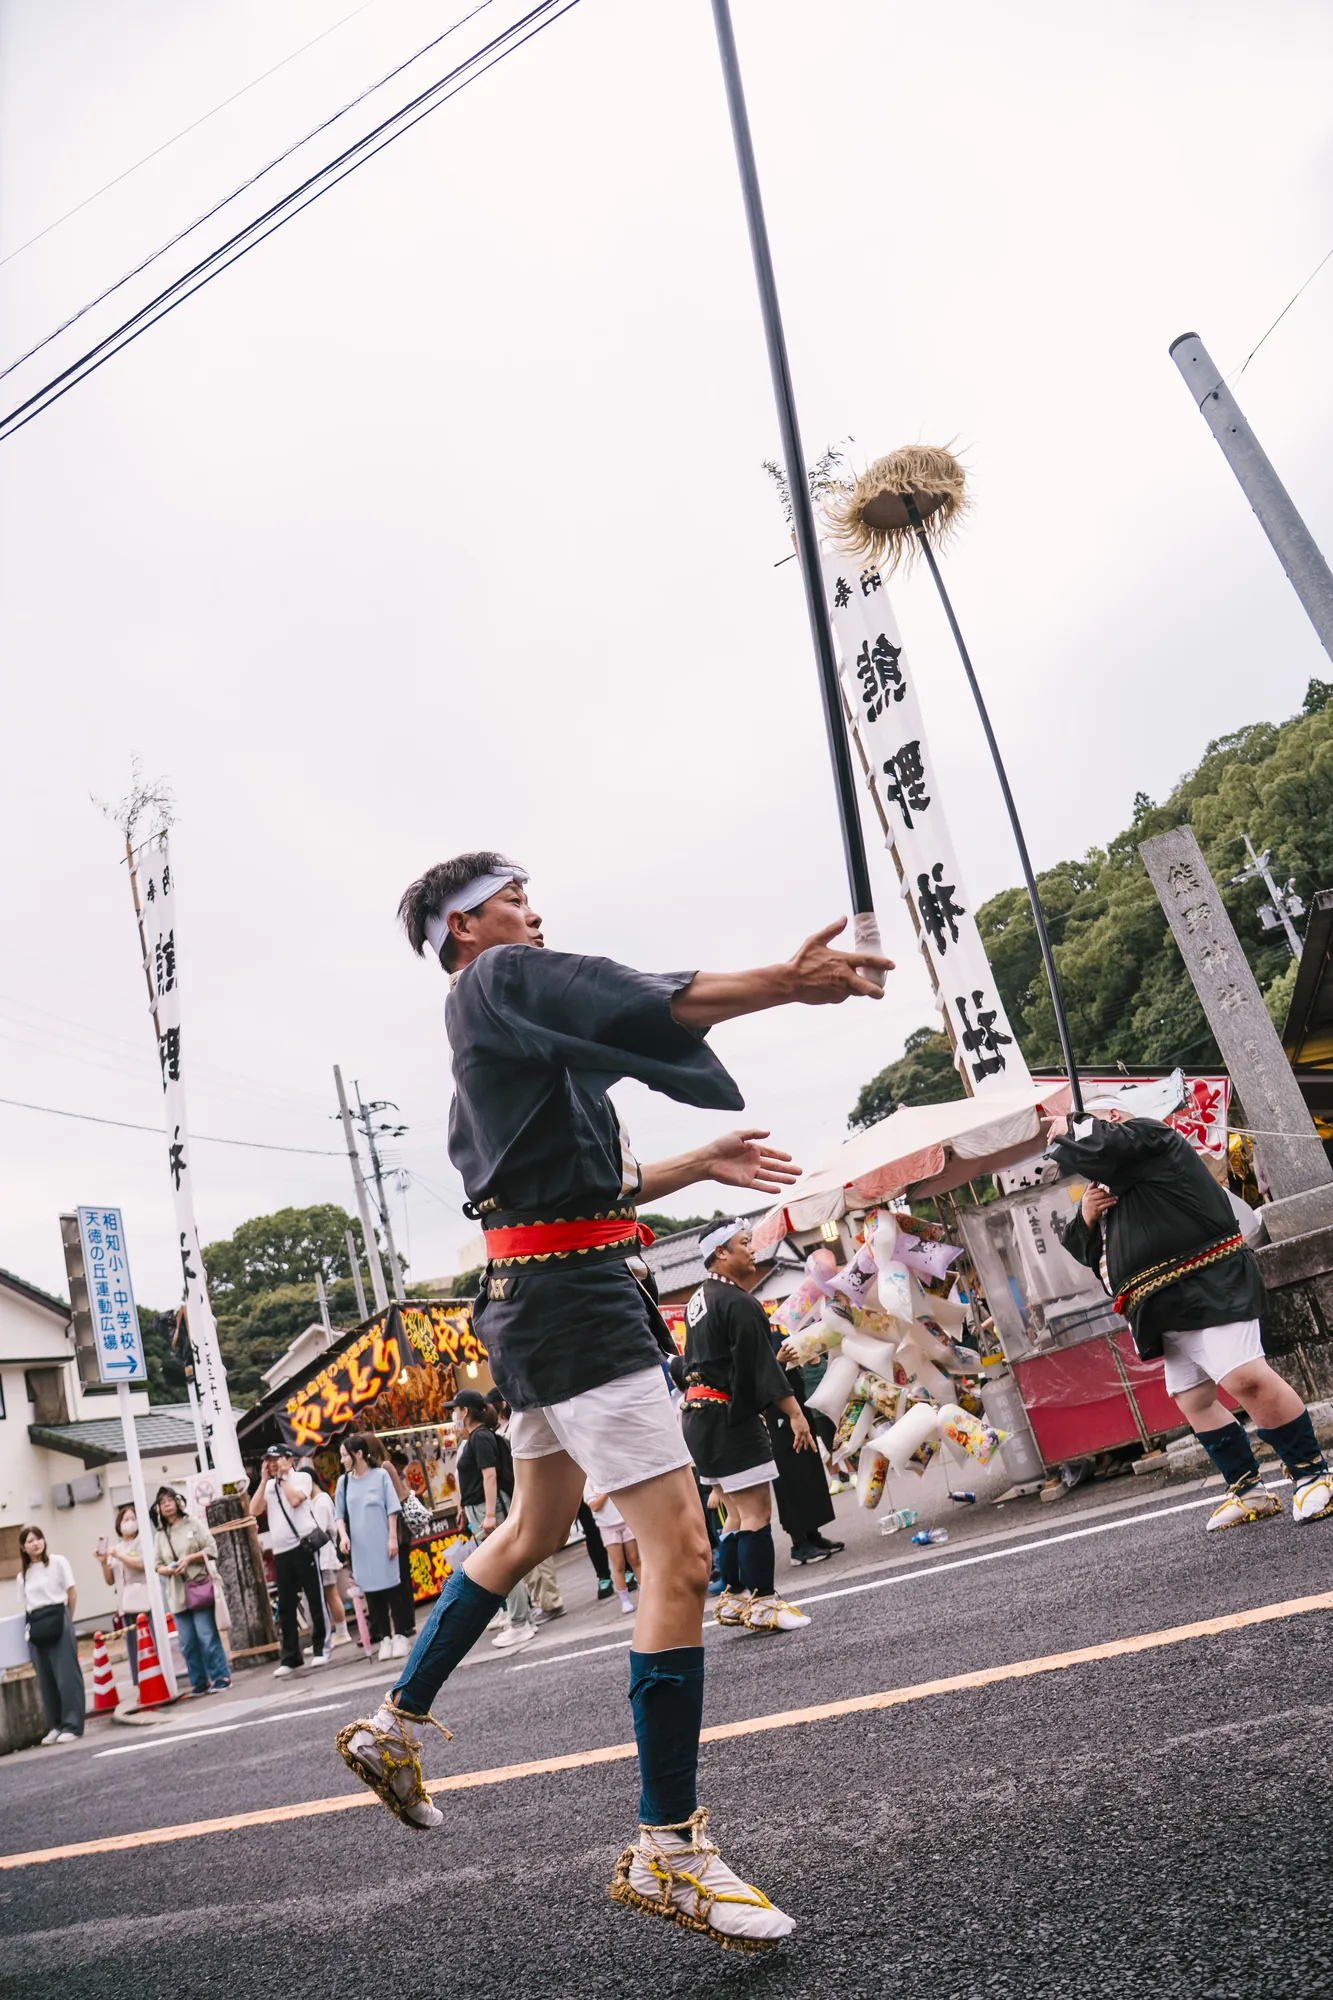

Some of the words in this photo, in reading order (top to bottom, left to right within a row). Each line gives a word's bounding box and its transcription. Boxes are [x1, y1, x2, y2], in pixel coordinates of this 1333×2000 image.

[1167, 862, 1249, 1014] 熊野神社
[86, 1211, 118, 1350] 天徳の丘運動広場
[103, 1213, 136, 1350] 相知小・中学校
[290, 1337, 402, 1446] やきとり
